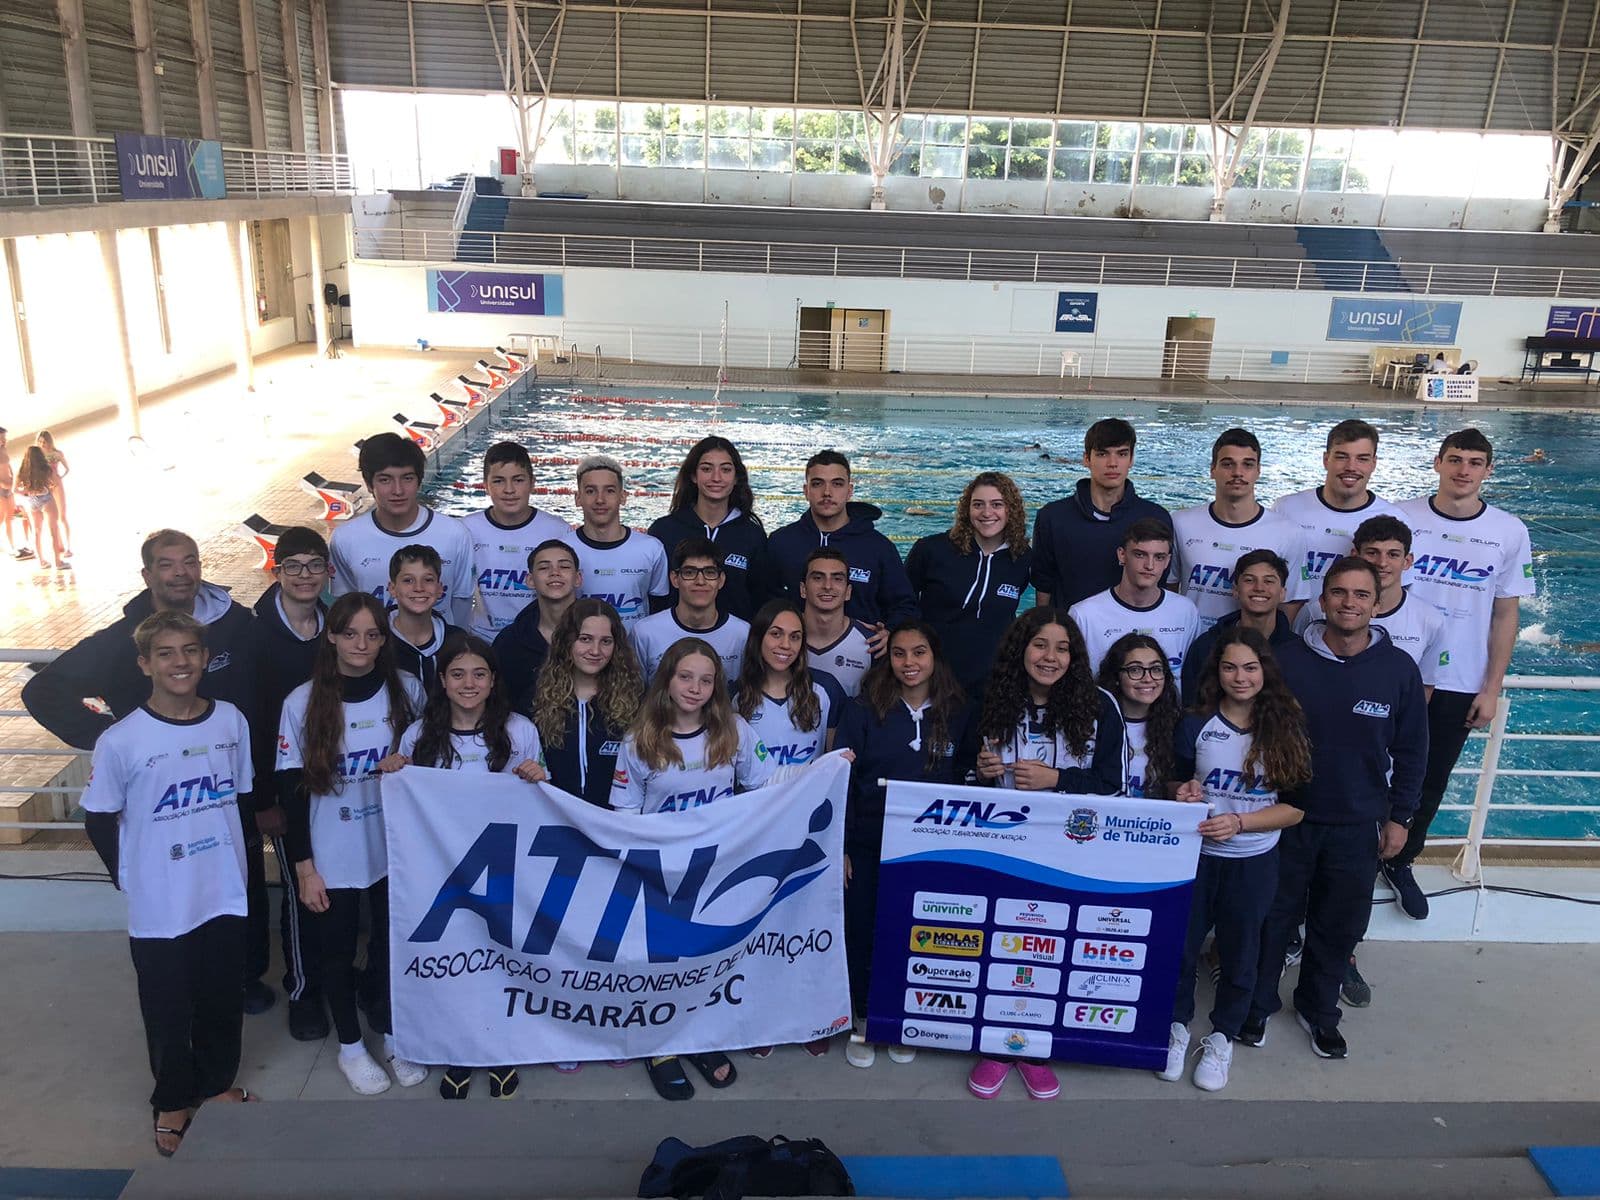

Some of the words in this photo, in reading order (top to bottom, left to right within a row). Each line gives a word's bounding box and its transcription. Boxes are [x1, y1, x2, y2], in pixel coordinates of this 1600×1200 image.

[1414, 554, 1469, 580] ATN
[478, 569, 528, 590] ATN
[767, 744, 798, 766] TN
[153, 774, 218, 814] ATN
[658, 786, 717, 813] ATN
[914, 799, 996, 828] ATN
[1105, 816, 1172, 831] Município
[1103, 829, 1120, 841] de
[1124, 831, 1180, 845] Tubarão
[408, 823, 719, 963] ATN
[922, 904, 973, 915] univinte
[934, 932, 980, 944] MOLAS
[404, 949, 551, 983] ASSOCIAÇÃO
[561, 964, 711, 993] TUBARONENSE
[714, 954, 739, 978] DE
[741, 928, 833, 964] NATAÇÃO
[1083, 942, 1135, 962] bite
[1096, 975, 1130, 984] CLINI-X
[503, 987, 676, 1028] TUBARÃO
[705, 974, 744, 1007] SC
[920, 1030, 949, 1039] Borges
